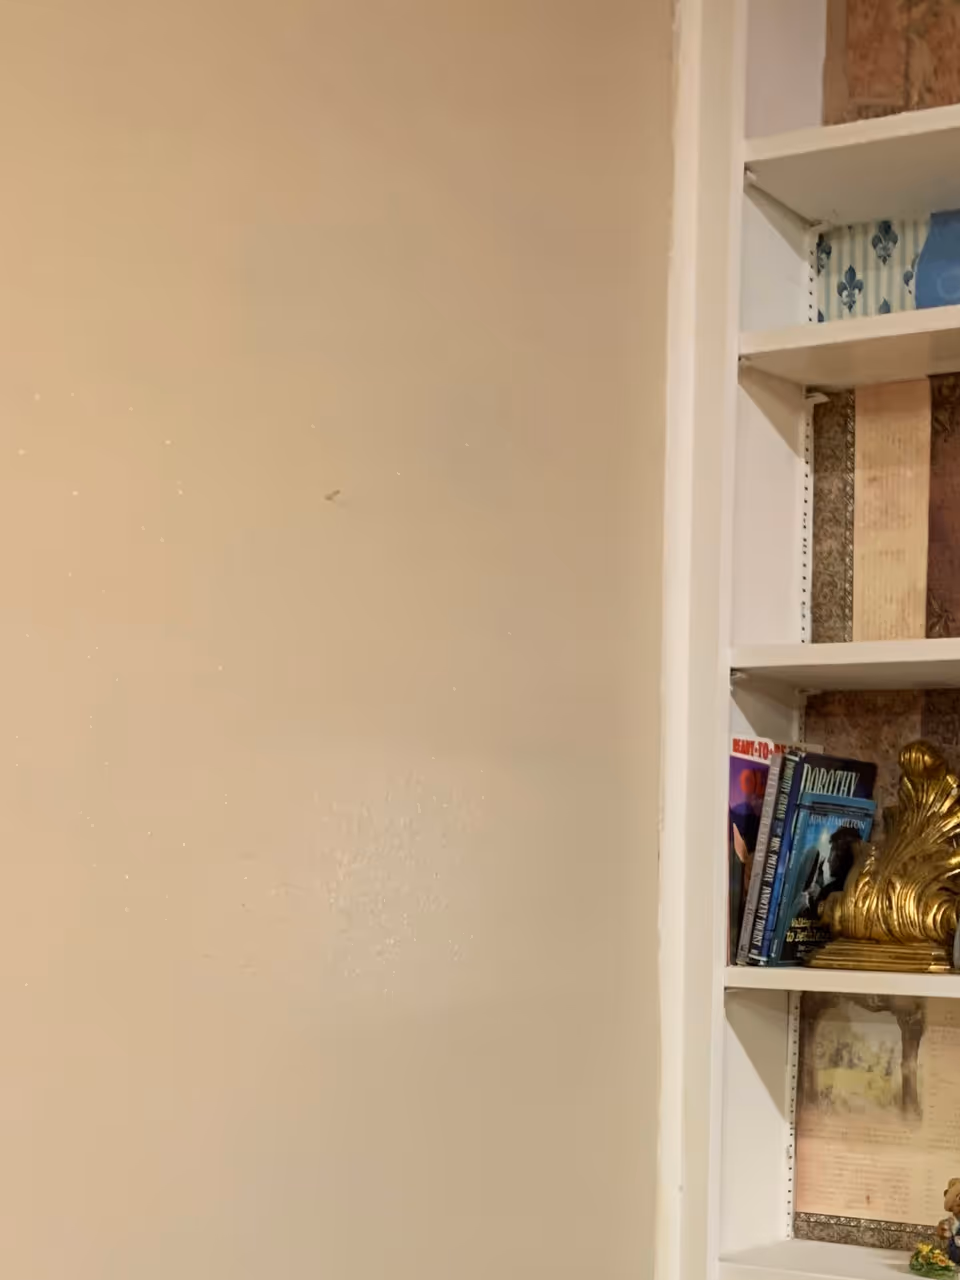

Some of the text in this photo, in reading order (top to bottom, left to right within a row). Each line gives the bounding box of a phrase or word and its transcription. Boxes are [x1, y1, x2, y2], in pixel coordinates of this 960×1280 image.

[782, 760, 797, 794] DOROTHY
[800, 763, 860, 799] DOROTHY
[829, 815, 867, 830] HAMILTON
[752, 918, 766, 947] TOURIST
